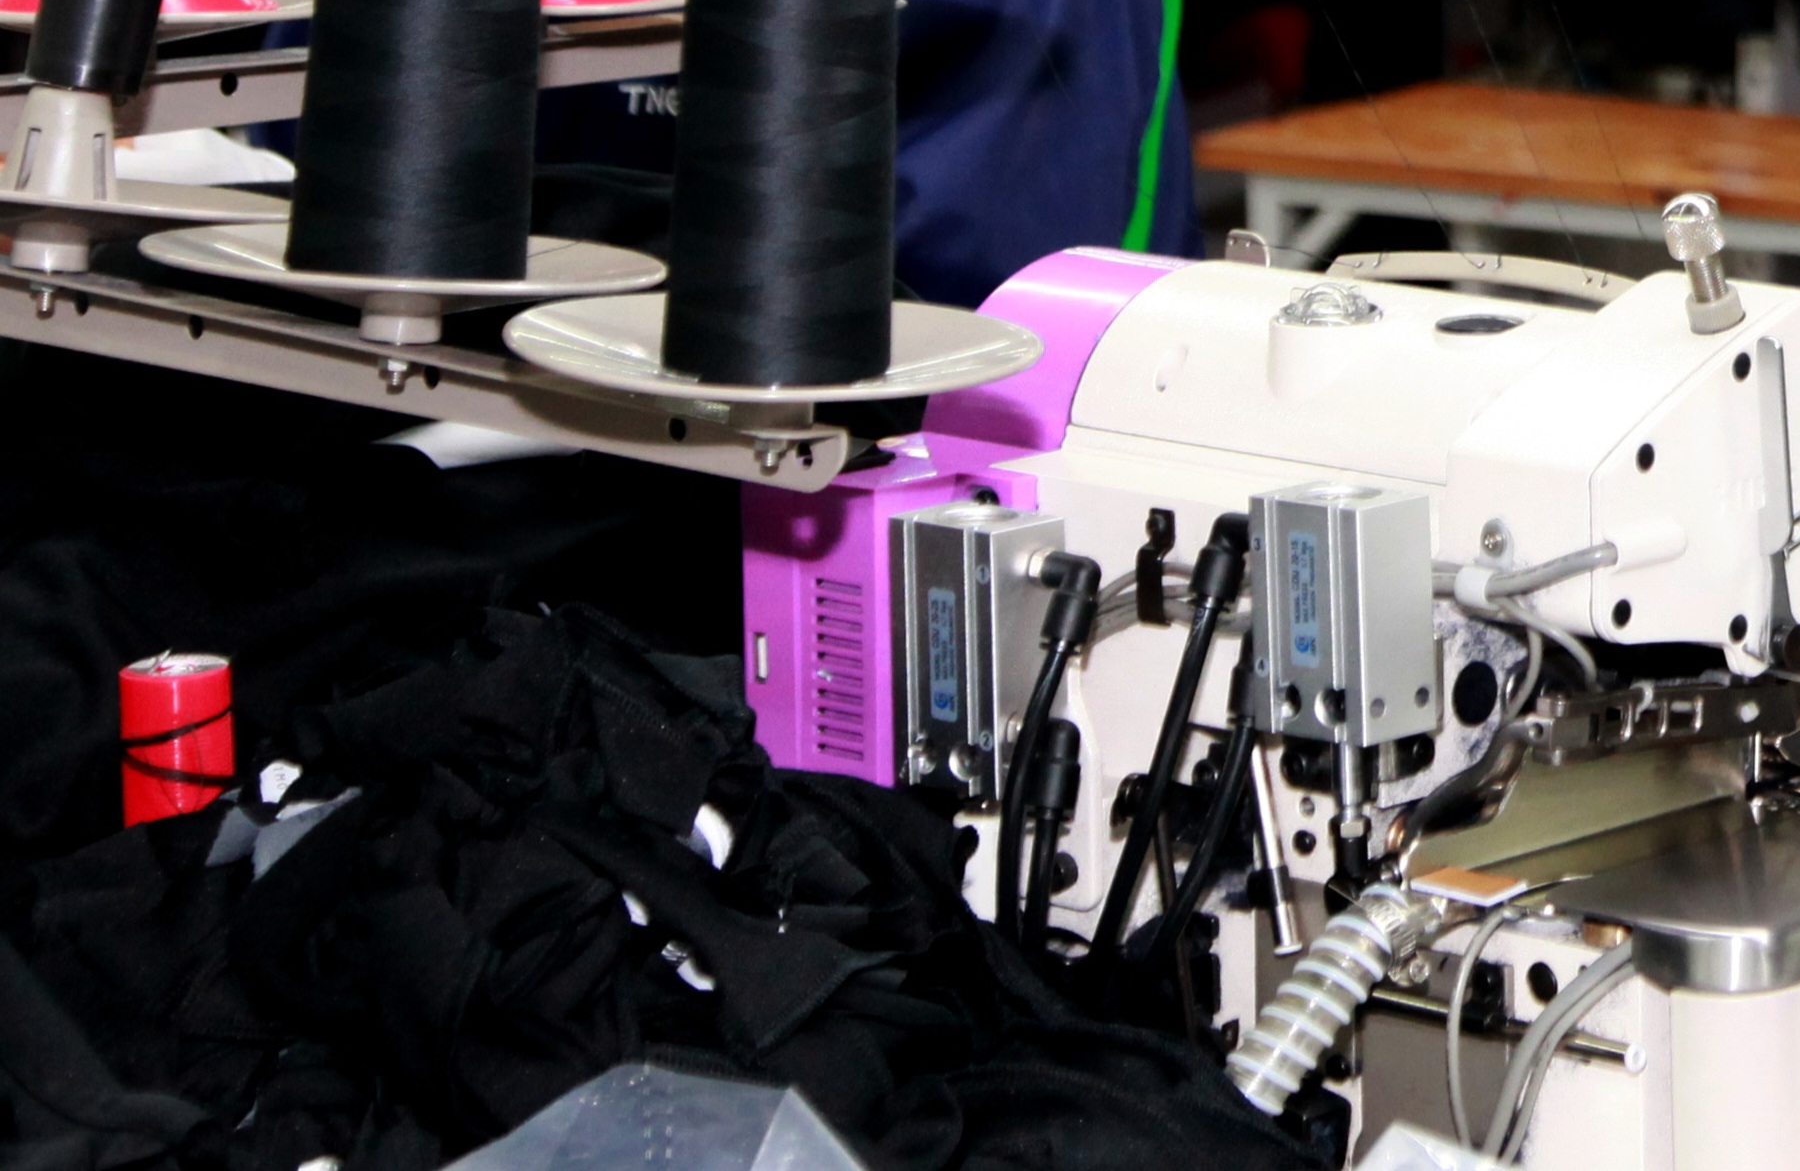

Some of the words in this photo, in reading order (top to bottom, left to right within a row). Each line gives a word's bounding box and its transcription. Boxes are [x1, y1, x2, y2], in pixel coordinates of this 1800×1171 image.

[1253, 537, 1261, 551] 3
[1257, 658, 1265, 671] 4
[983, 734, 990, 748] 2
